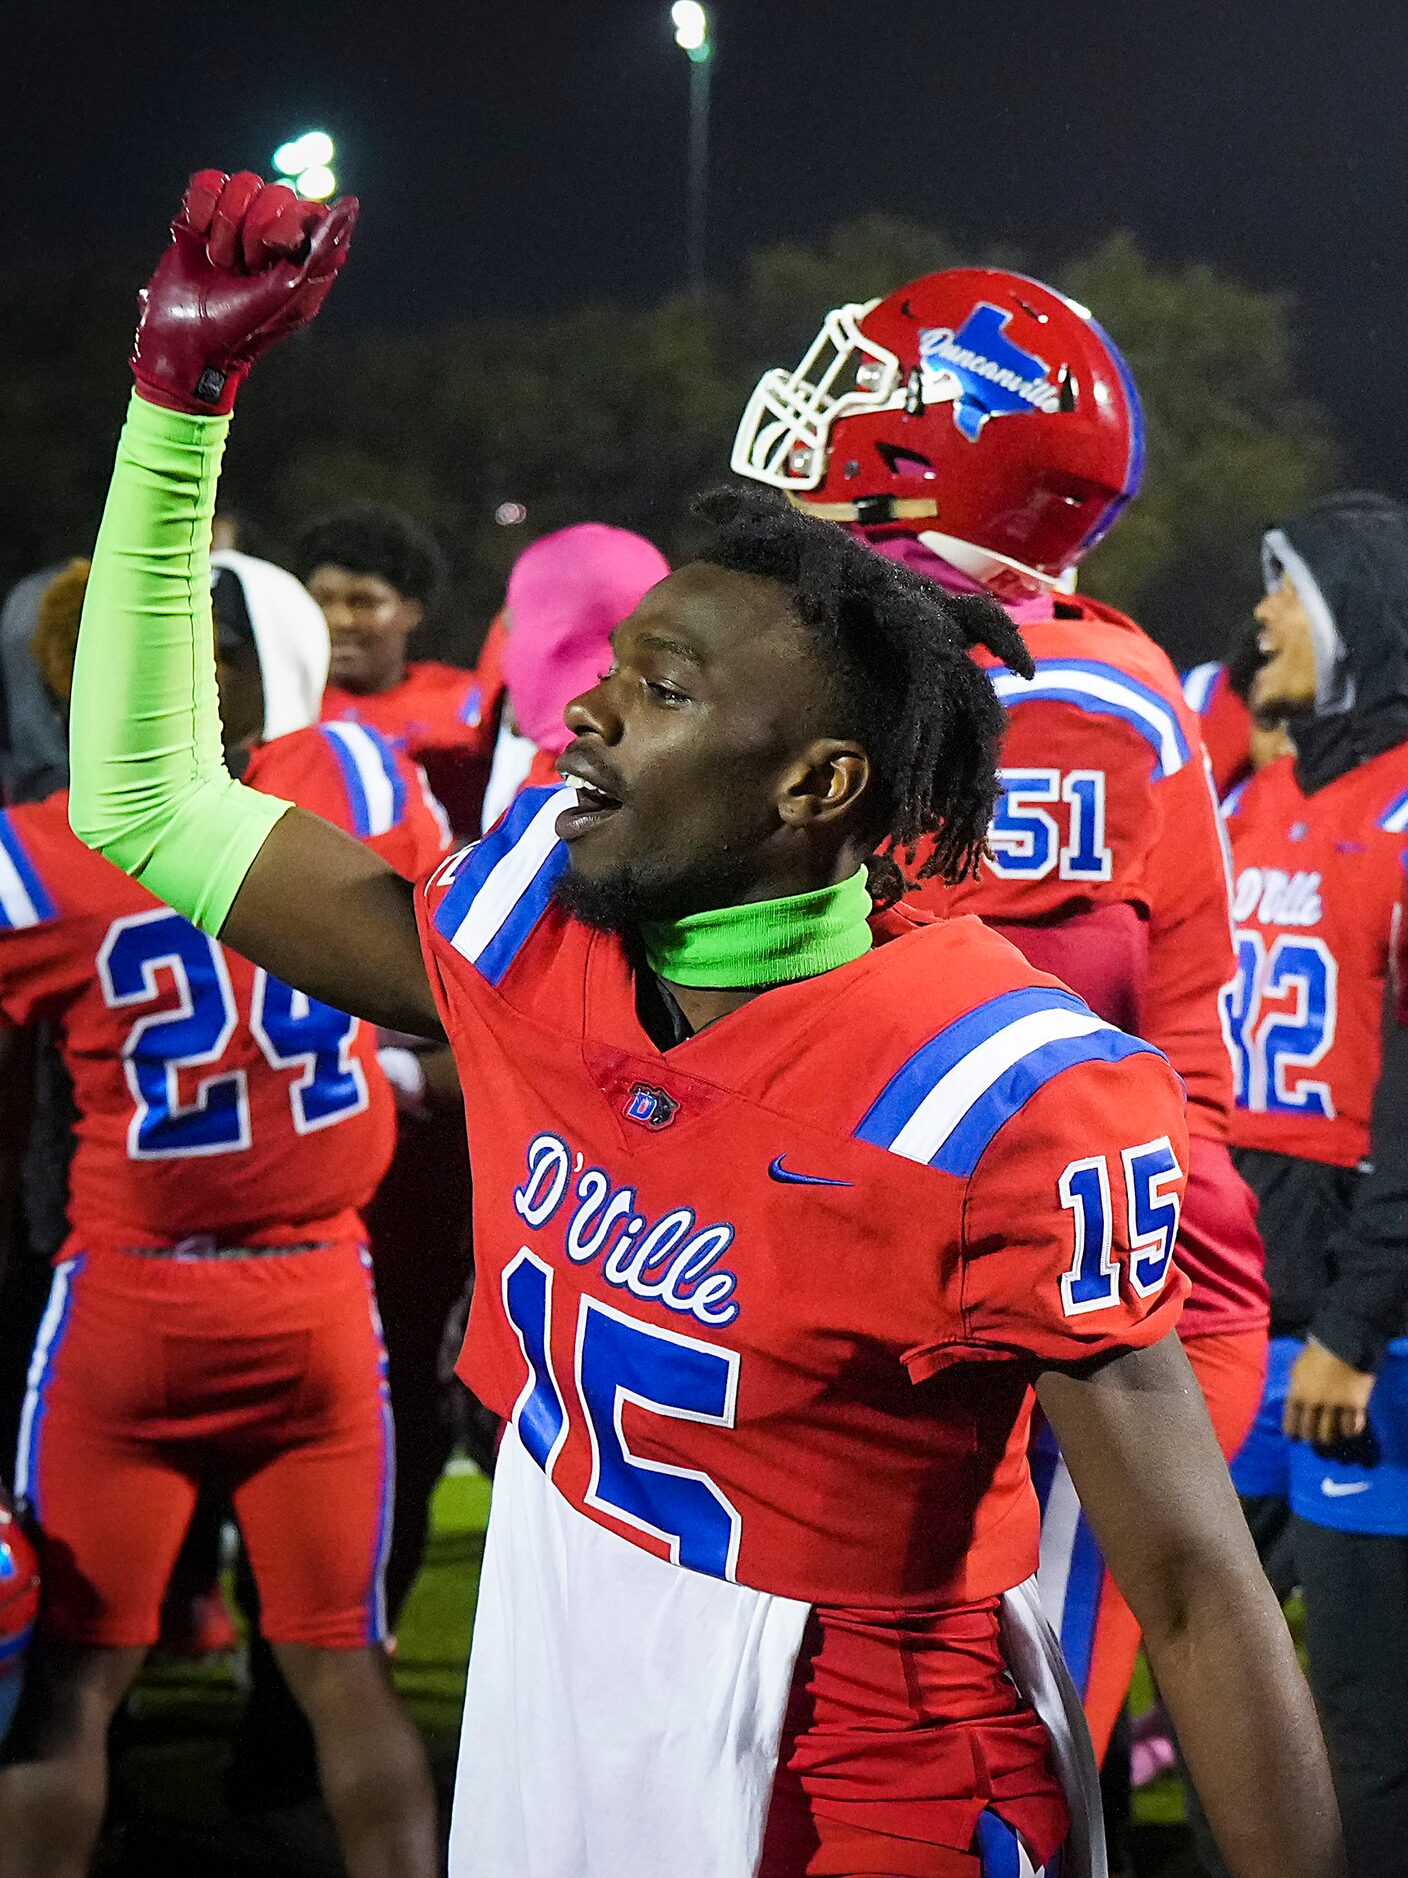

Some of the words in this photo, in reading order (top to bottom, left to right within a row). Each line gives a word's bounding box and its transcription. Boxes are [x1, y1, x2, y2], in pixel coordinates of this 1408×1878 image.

[982, 767, 1113, 882] 51
[95, 905, 370, 1161] 24
[513, 1131, 741, 1330] D'Ville
[1058, 1135, 1184, 1317] 15
[501, 1245, 742, 1585] 15
